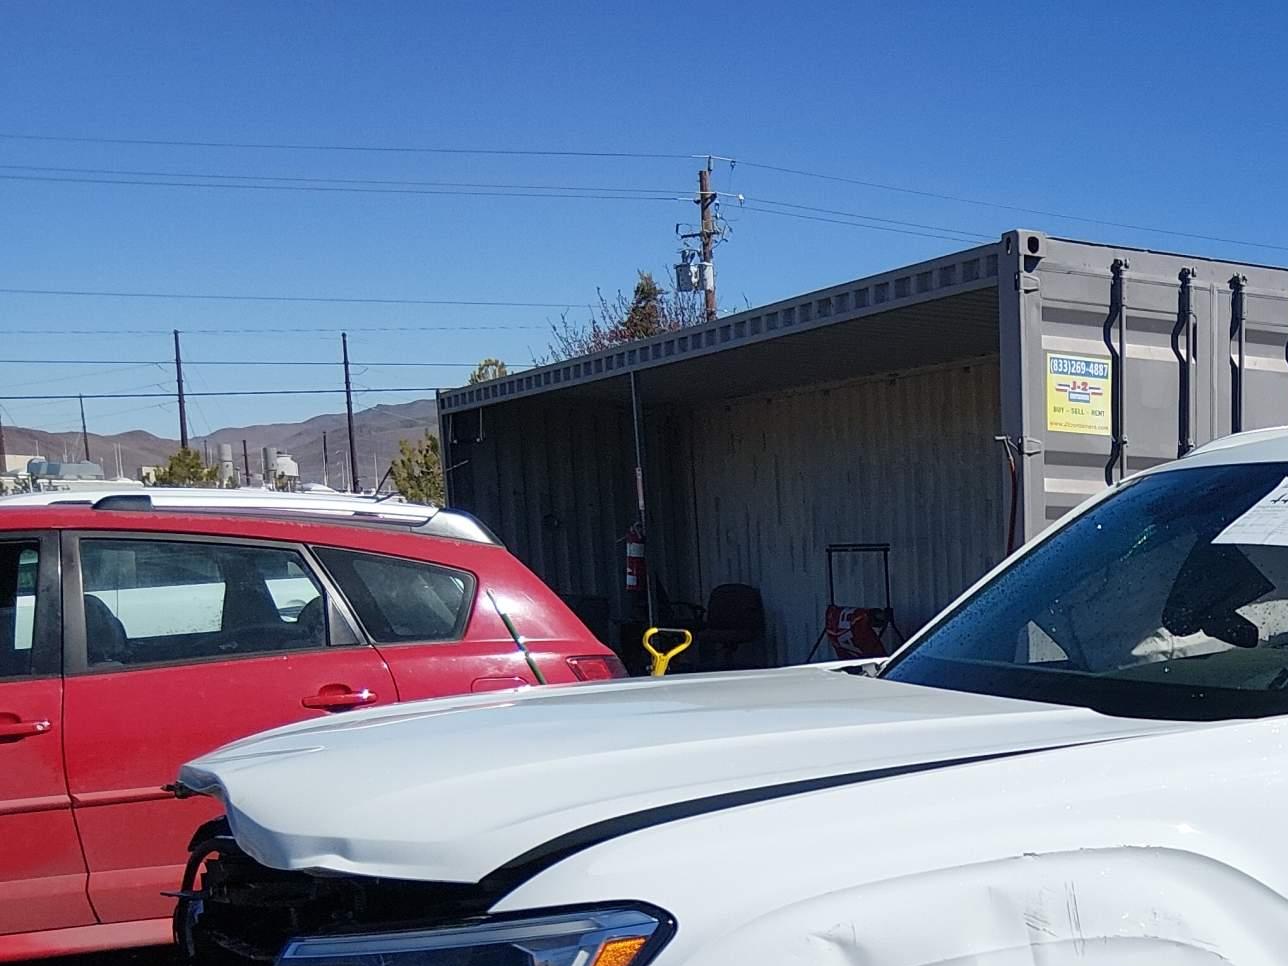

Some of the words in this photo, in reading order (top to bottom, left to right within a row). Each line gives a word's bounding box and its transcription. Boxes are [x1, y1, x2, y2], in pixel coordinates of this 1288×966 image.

[1050, 358, 1108, 377] (833)269-4887
[1053, 406, 1064, 414] BUY
[1071, 408, 1085, 416] SELL
